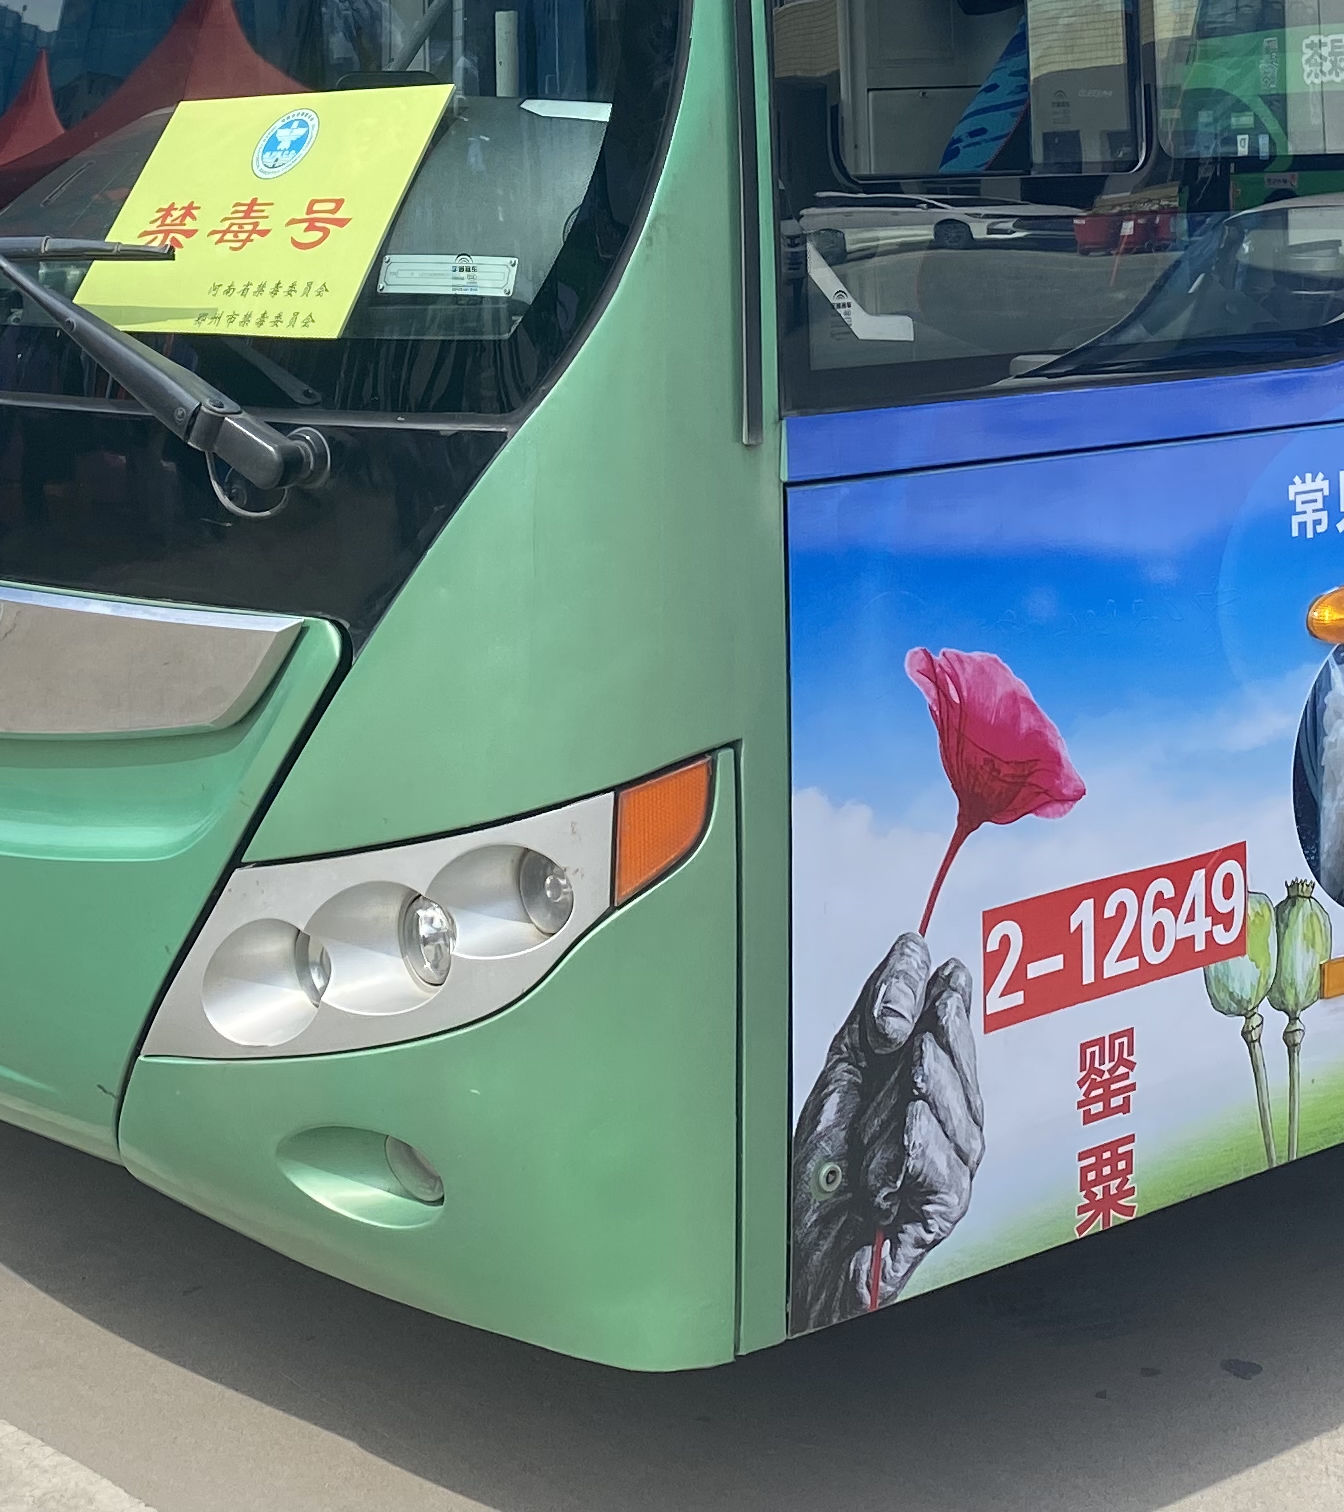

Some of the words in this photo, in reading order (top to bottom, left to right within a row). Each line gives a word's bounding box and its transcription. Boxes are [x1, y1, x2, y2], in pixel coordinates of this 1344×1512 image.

[136, 197, 353, 252] 禁毒号
[207, 281, 330, 298] 河南省禁毒委员会
[193, 310, 316, 329] 郑州市禁毒委员会
[985, 858, 1245, 1016] 2-12649
[1075, 1025, 1138, 1239] 罂粟
